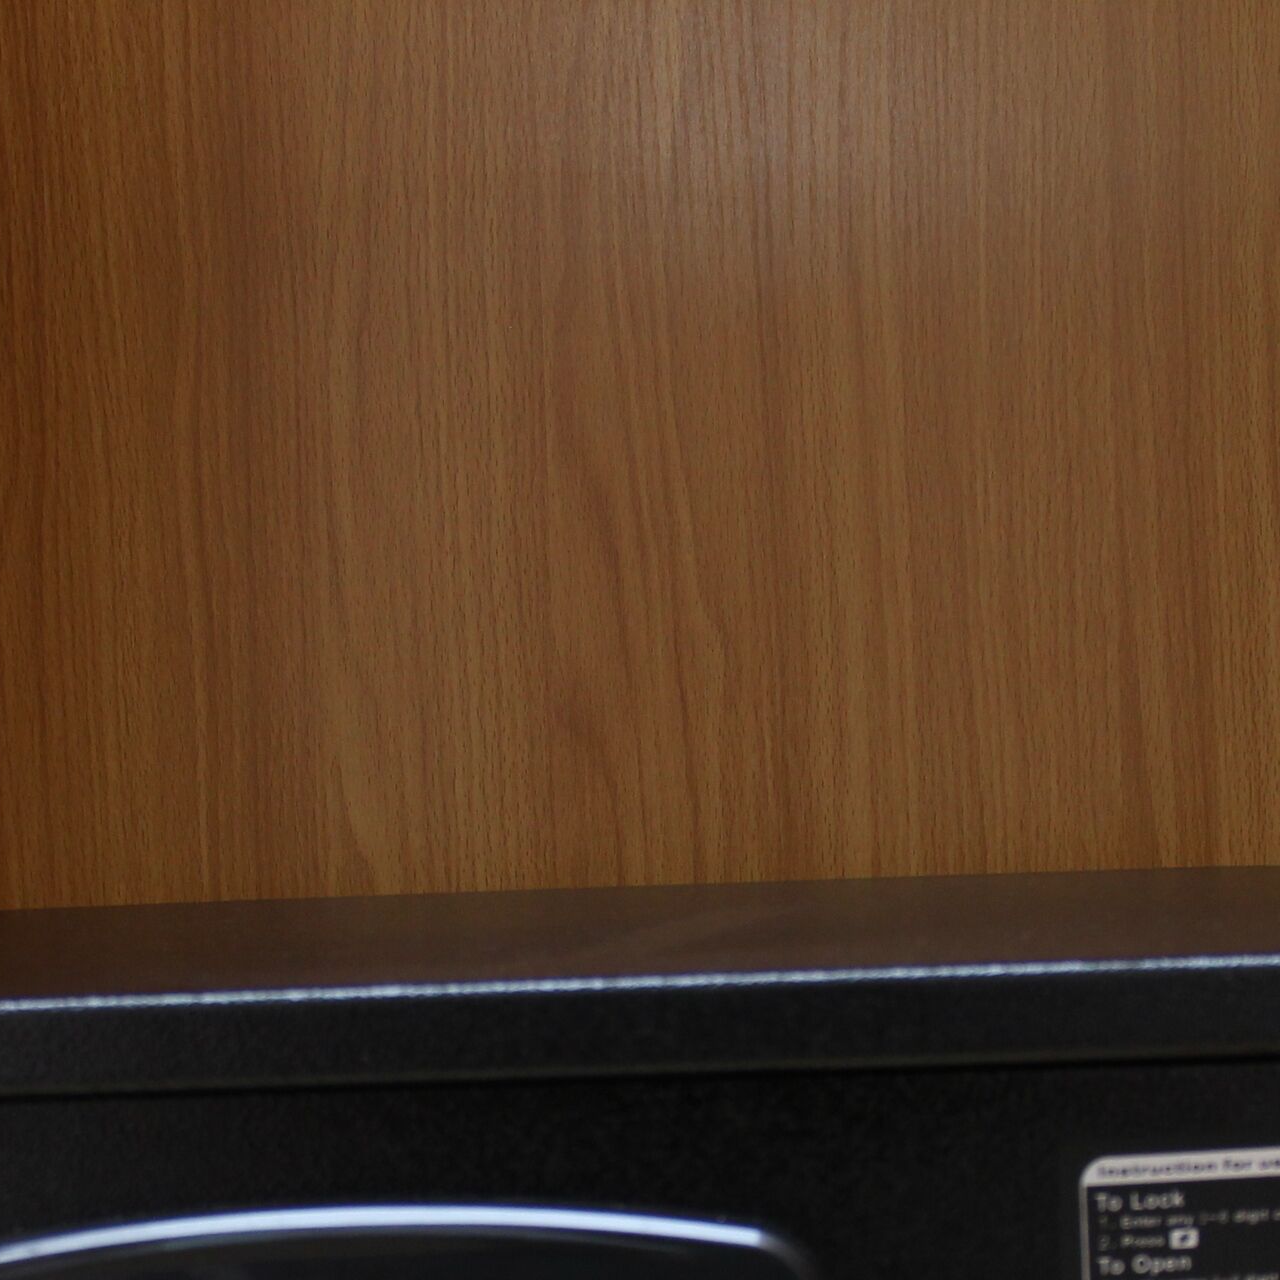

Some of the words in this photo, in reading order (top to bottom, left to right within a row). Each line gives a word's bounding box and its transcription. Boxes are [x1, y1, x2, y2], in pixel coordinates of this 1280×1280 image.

[1095, 1191, 1123, 1212] To
[1128, 1188, 1186, 1211] Lock
[1096, 1255, 1126, 1277] To
[1130, 1253, 1193, 1277] Open
